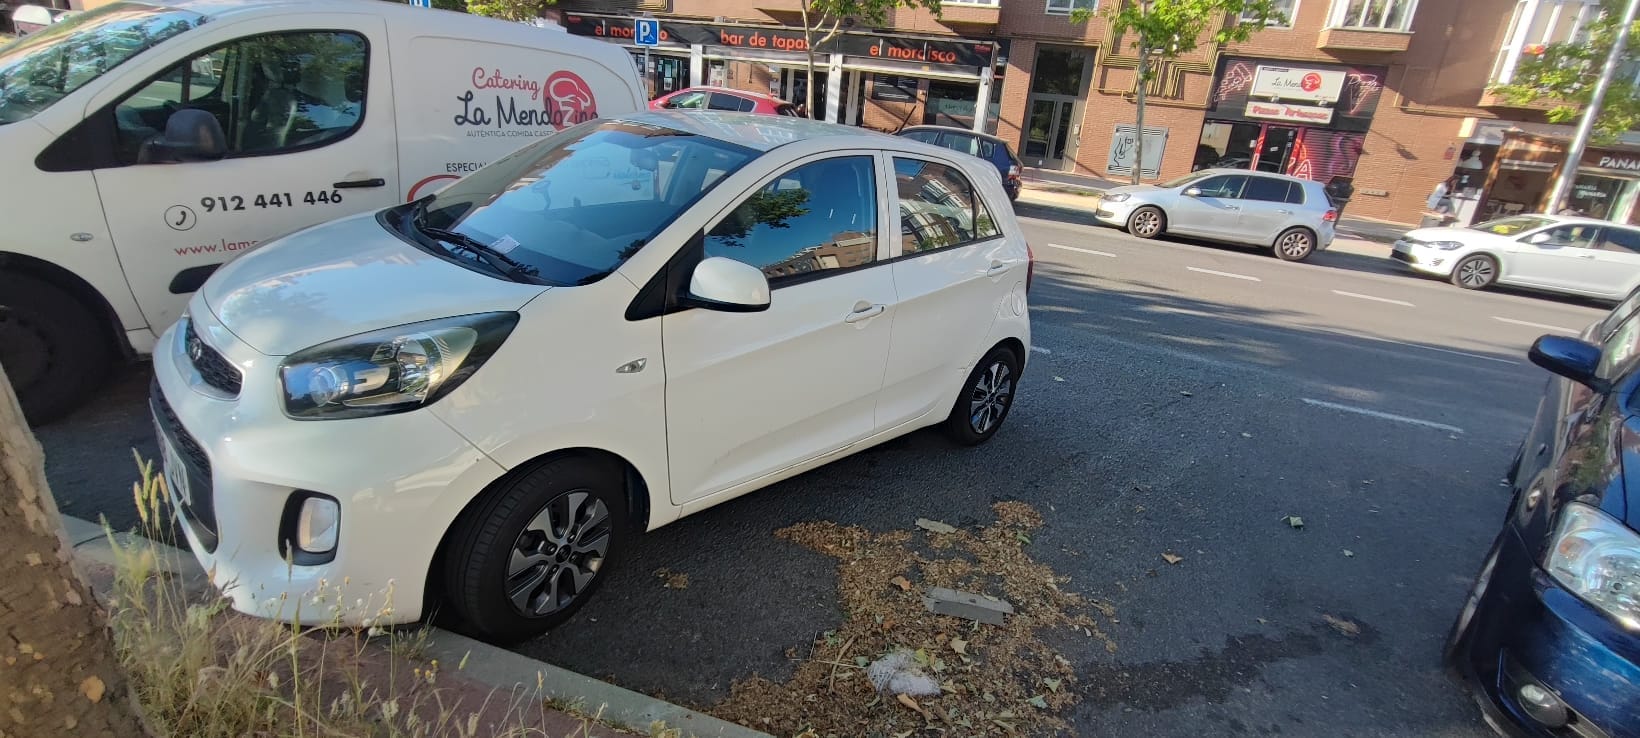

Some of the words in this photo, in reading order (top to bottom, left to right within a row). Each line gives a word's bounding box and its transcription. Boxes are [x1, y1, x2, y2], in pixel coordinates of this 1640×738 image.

[639, 21, 651, 42] P
[720, 29, 744, 45] bar
[749, 32, 767, 47] de
[870, 38, 882, 56] el
[888, 41, 957, 63] mordisco
[472, 66, 541, 101] Catering
[454, 90, 491, 126] La
[507, 130, 534, 138] COMIDA
[200, 195, 246, 213] 912
[254, 192, 293, 209] 441
[303, 189, 343, 206] 446
